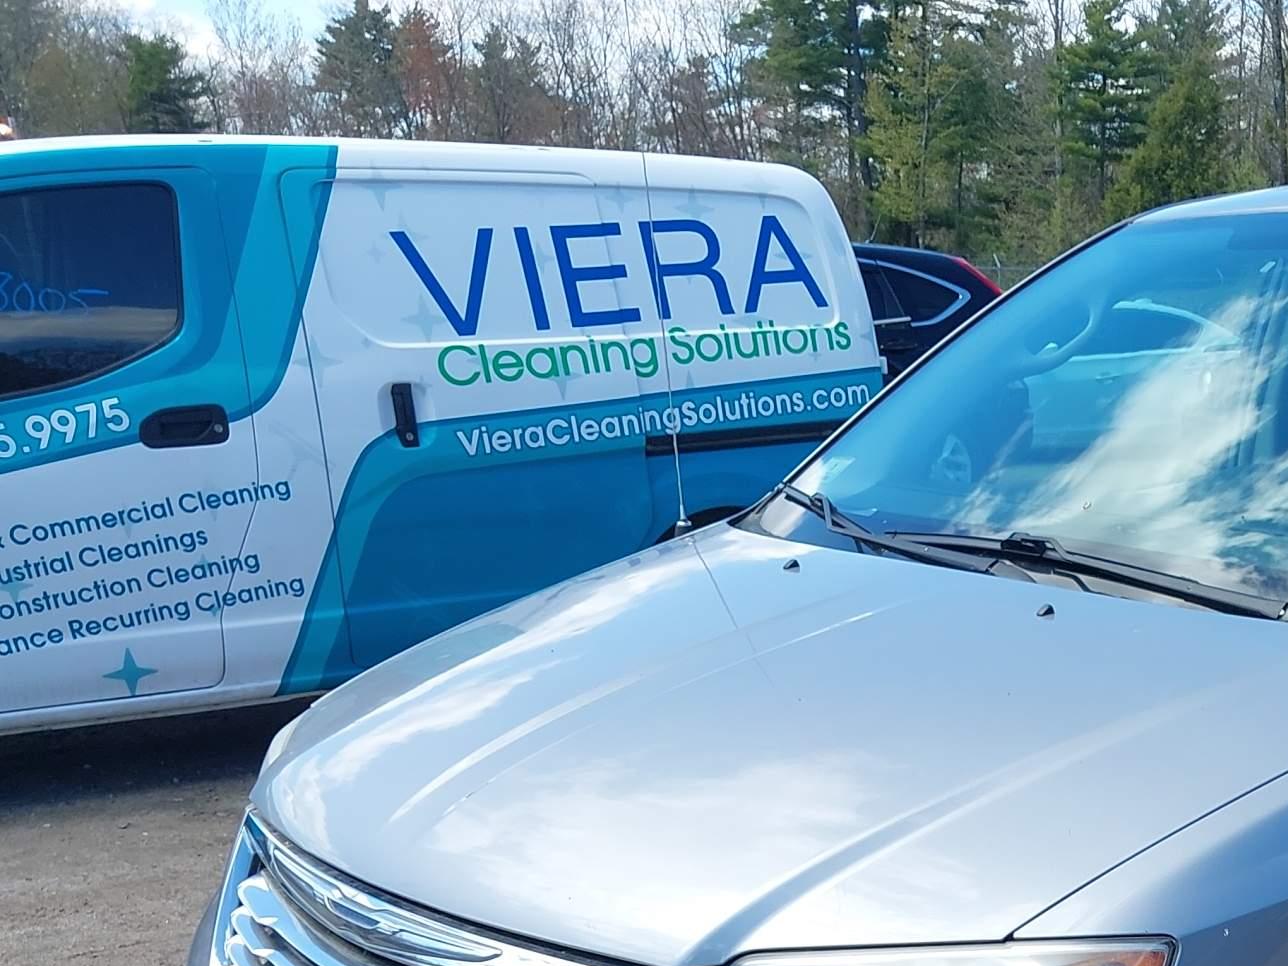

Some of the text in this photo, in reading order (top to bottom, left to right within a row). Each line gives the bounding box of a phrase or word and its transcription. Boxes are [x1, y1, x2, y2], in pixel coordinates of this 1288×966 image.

[389, 215, 829, 336] VIERA
[438, 319, 852, 387] Cleaning Solutions
[456, 382, 870, 457] VieraCleaningSolutions.com
[9, 480, 291, 545] Commercial Cleaning
[0, 529, 208, 585] ustrial Cleanings
[0, 553, 260, 620] onstruction Cleaning
[0, 577, 305, 656] ance Recurring Cleaning
